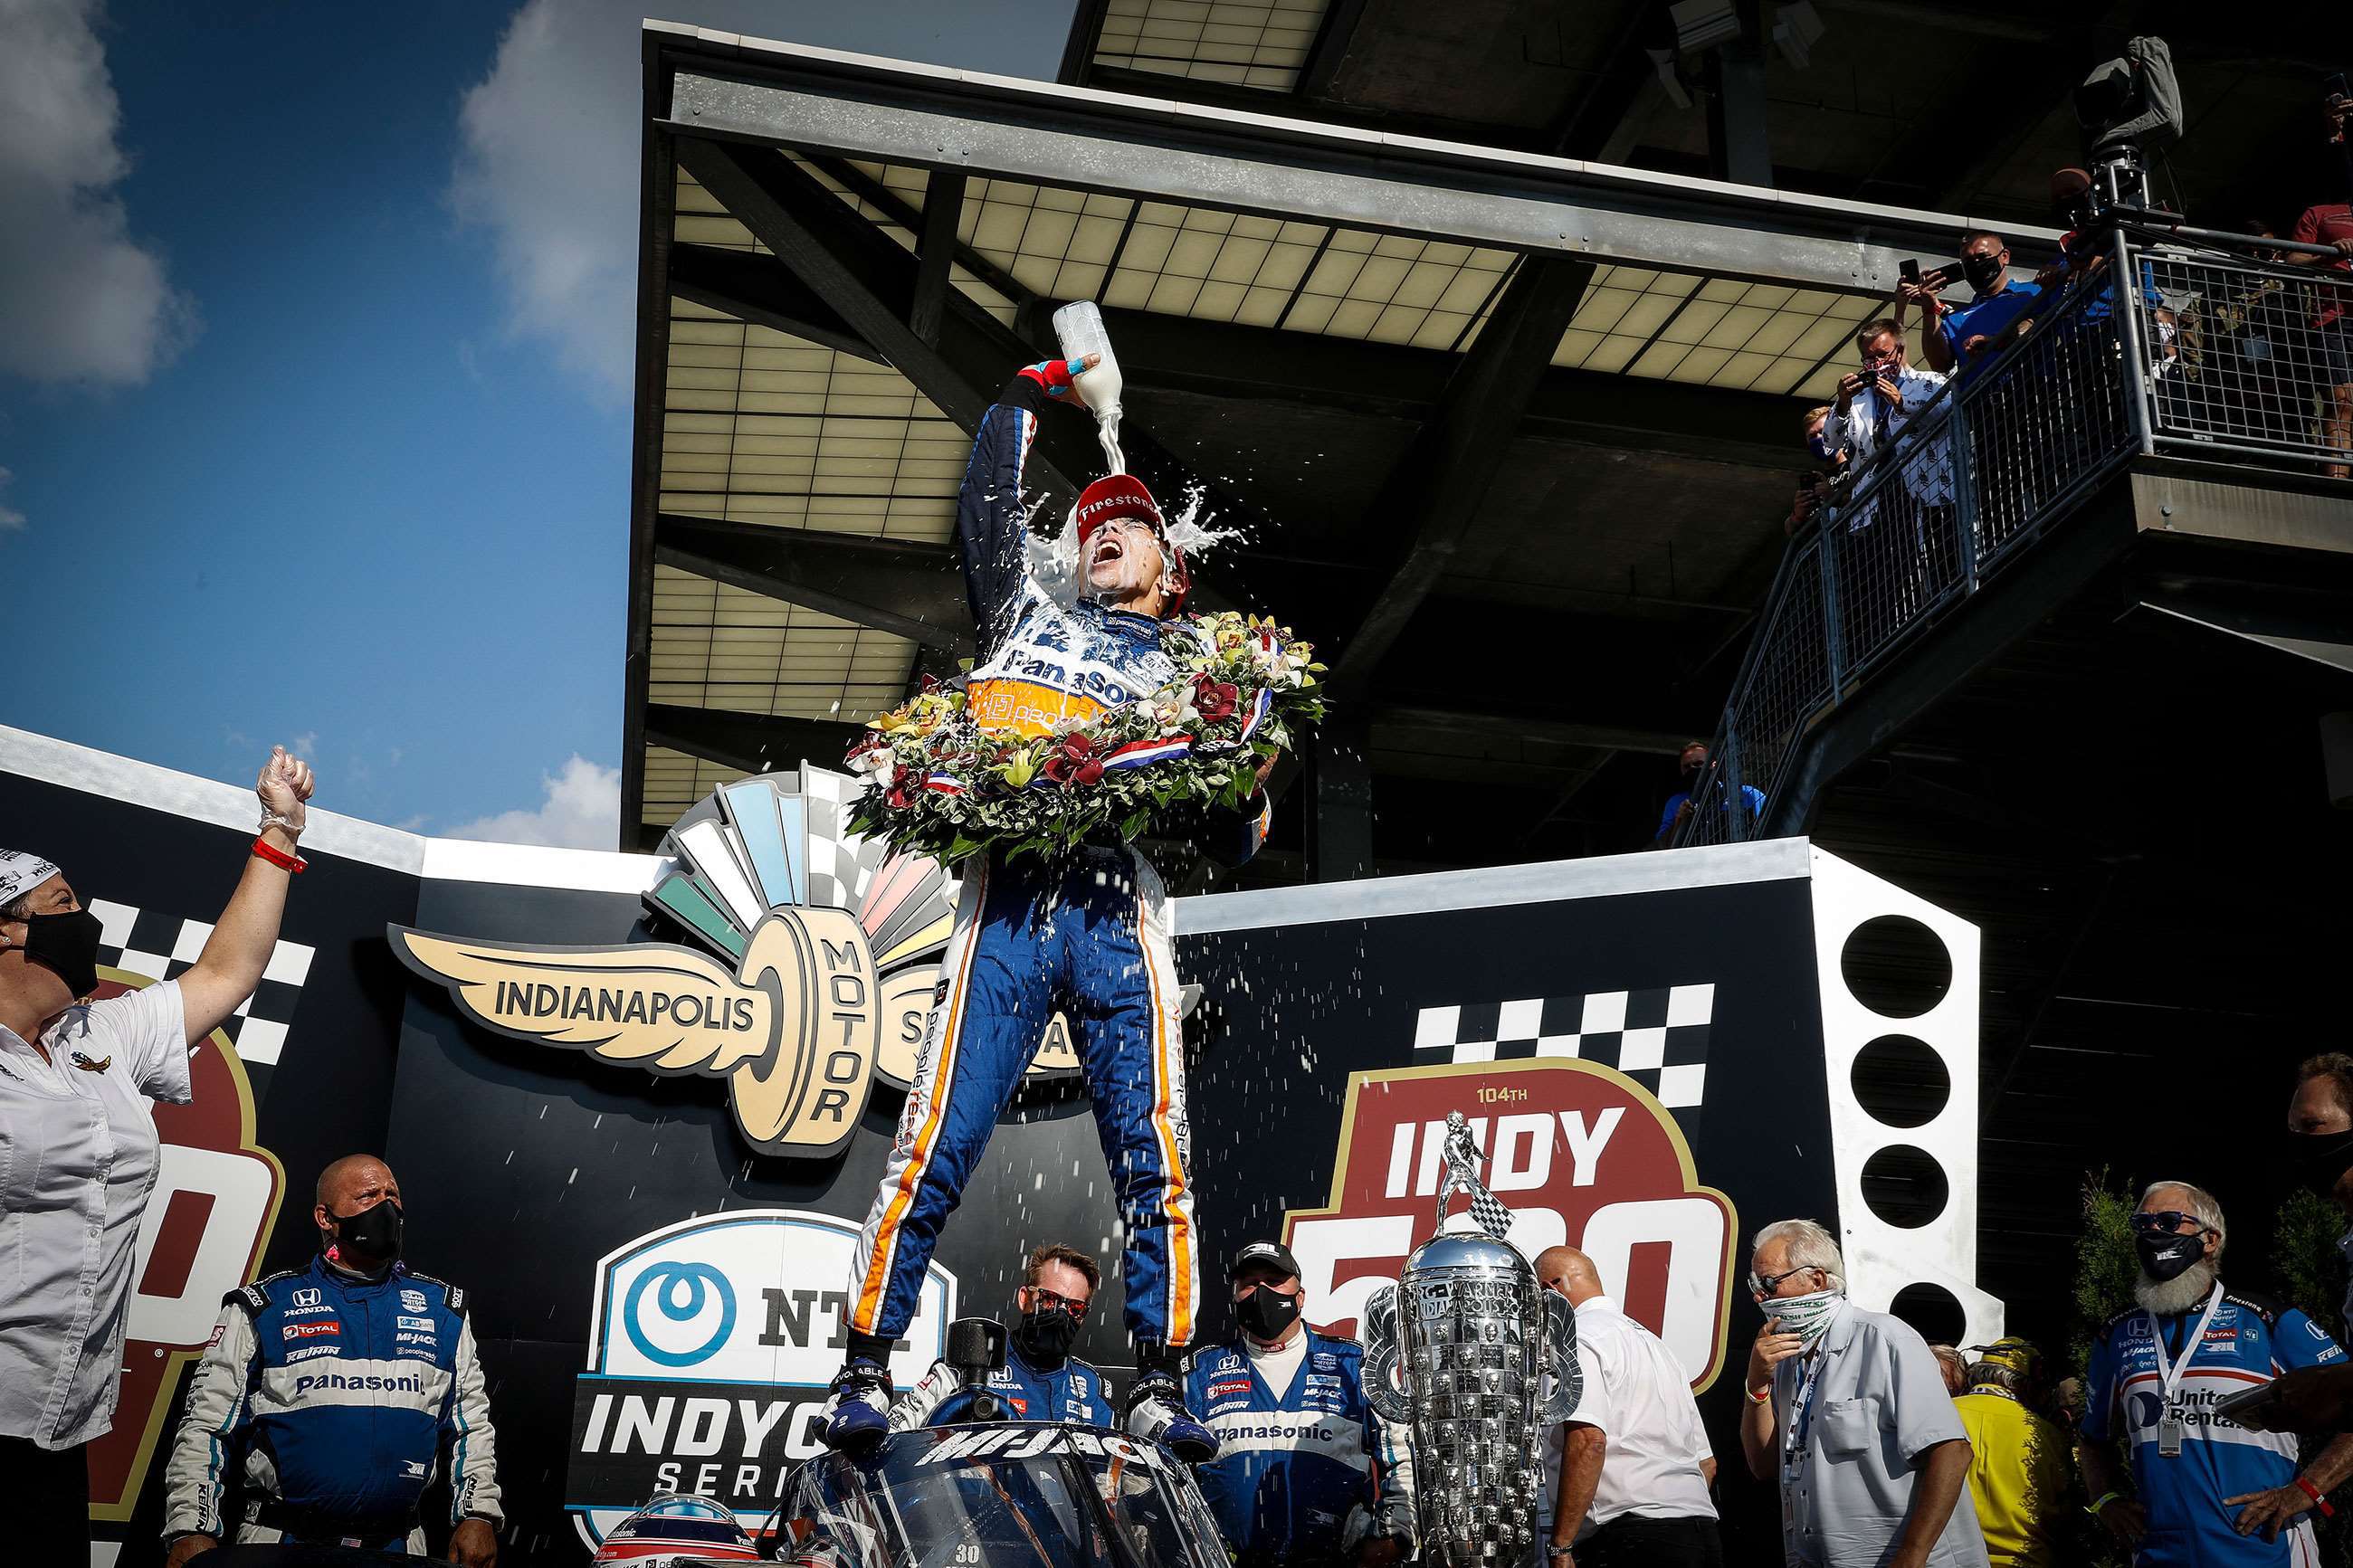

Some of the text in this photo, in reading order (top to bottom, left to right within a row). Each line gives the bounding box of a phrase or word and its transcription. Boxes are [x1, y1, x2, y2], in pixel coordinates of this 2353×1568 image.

[1080, 494, 1157, 521] Firestone
[1002, 649, 1131, 704] Panaso
[495, 981, 754, 1032] INDIANAPOLIS
[809, 938, 866, 1123] MOTOR
[905, 1011, 938, 1145] peopleread
[1477, 1087, 1528, 1104] 104TH
[1385, 1107, 1626, 1199] INDY
[1291, 1198, 1724, 1383] 50
[284, 1306, 335, 1317] HONDA
[2225, 1295, 2262, 1312] Firestone
[298, 1325, 338, 1334] TOTAL
[2205, 1330, 2236, 1338] TOTAL
[2119, 1337, 2154, 1348] HOND
[295, 1373, 426, 1396] Panasonic
[1209, 1367, 1248, 1380] HONDA
[581, 1393, 829, 1460] INDYC
[653, 1461, 787, 1499] SERI
[956, 1544, 980, 1563] 30
